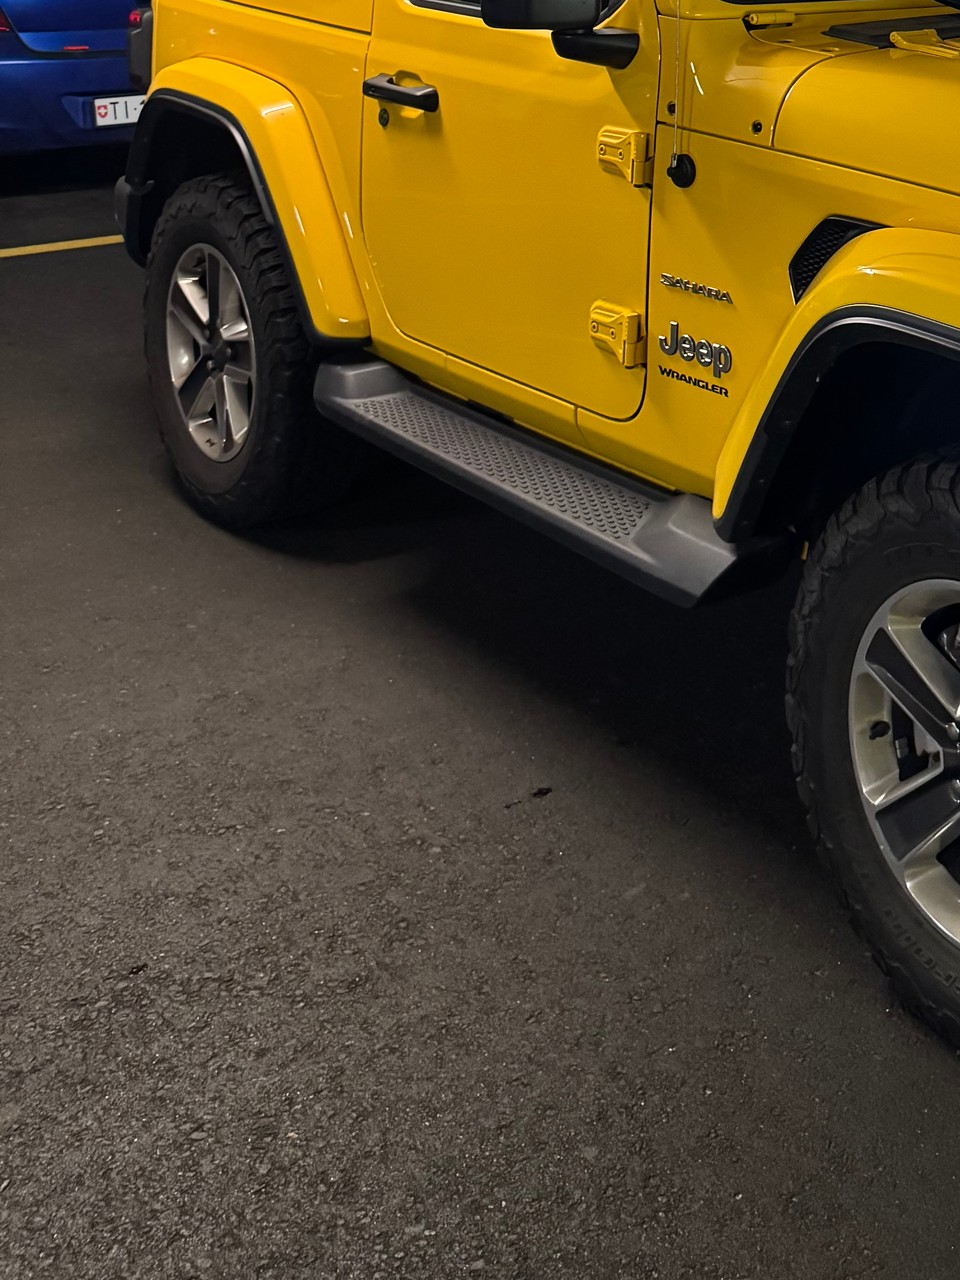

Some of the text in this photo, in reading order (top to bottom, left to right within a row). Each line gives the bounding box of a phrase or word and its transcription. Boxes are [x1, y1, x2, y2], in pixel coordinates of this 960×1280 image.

[660, 272, 733, 304] SAHARA
[658, 320, 732, 379] Jeep
[658, 364, 729, 397] WRANGLER
